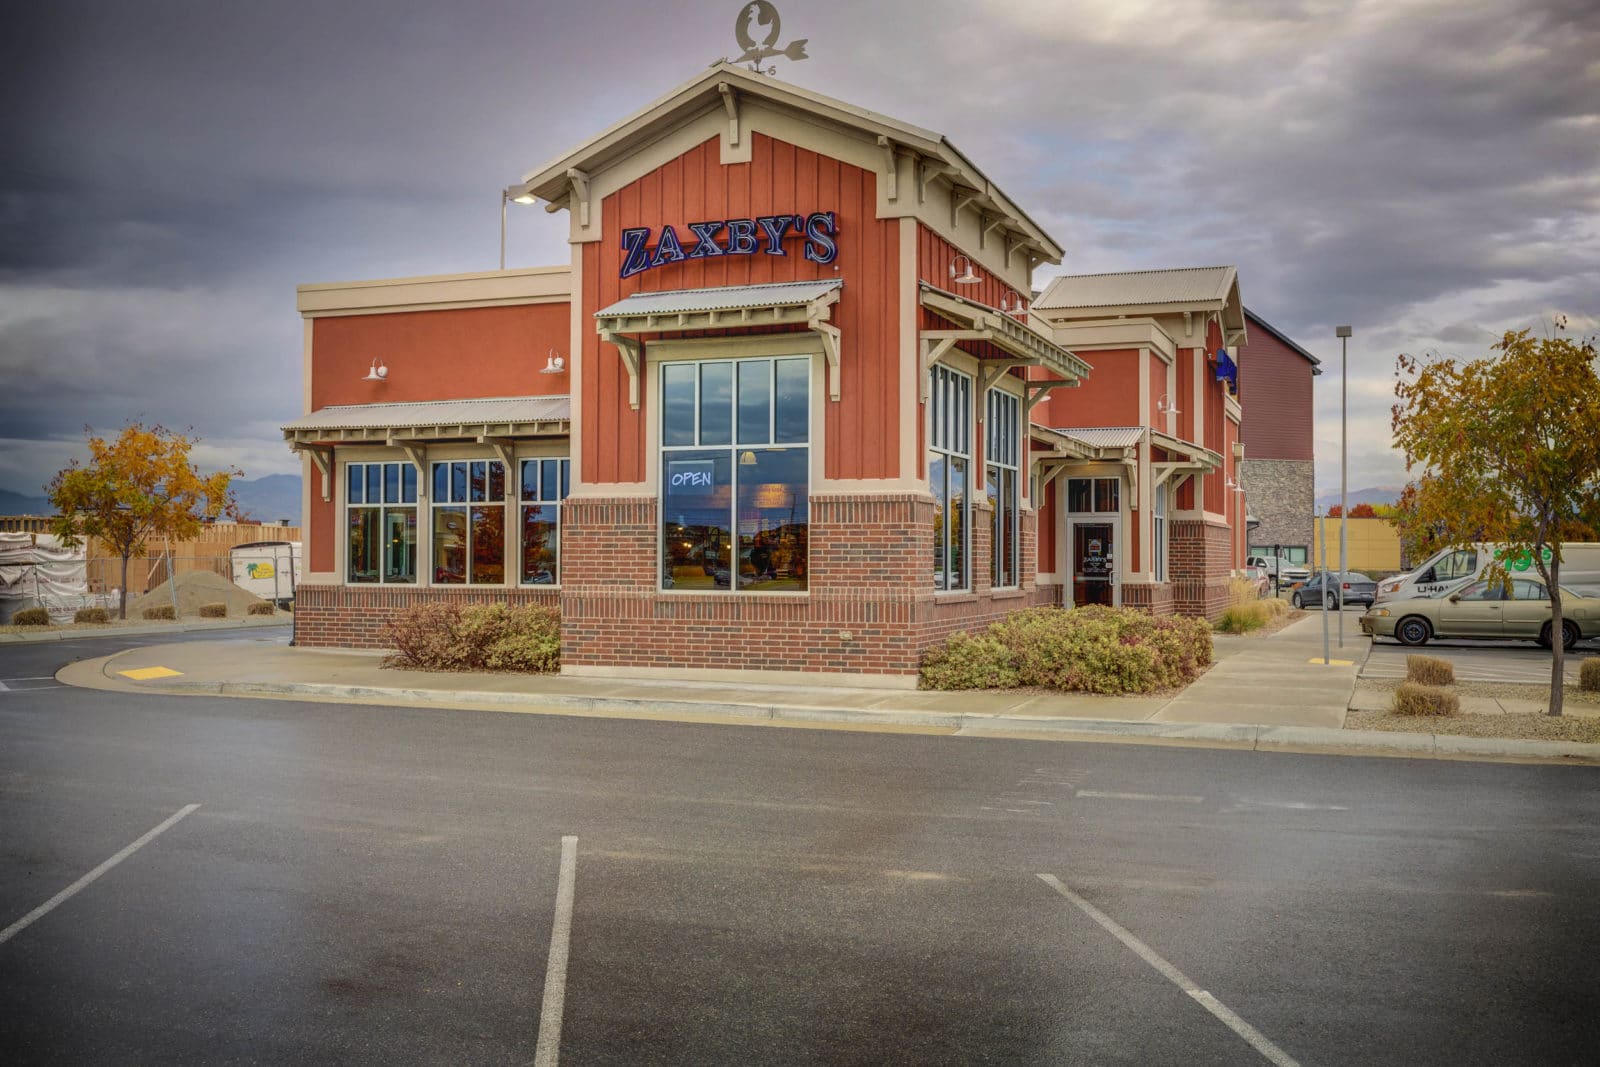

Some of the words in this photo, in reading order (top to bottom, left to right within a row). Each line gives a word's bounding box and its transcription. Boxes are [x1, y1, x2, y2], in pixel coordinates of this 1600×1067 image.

[620, 211, 838, 279] ZAXBY'S
[671, 471, 711, 486] OPEN
[1417, 585, 1449, 593] U-HA
